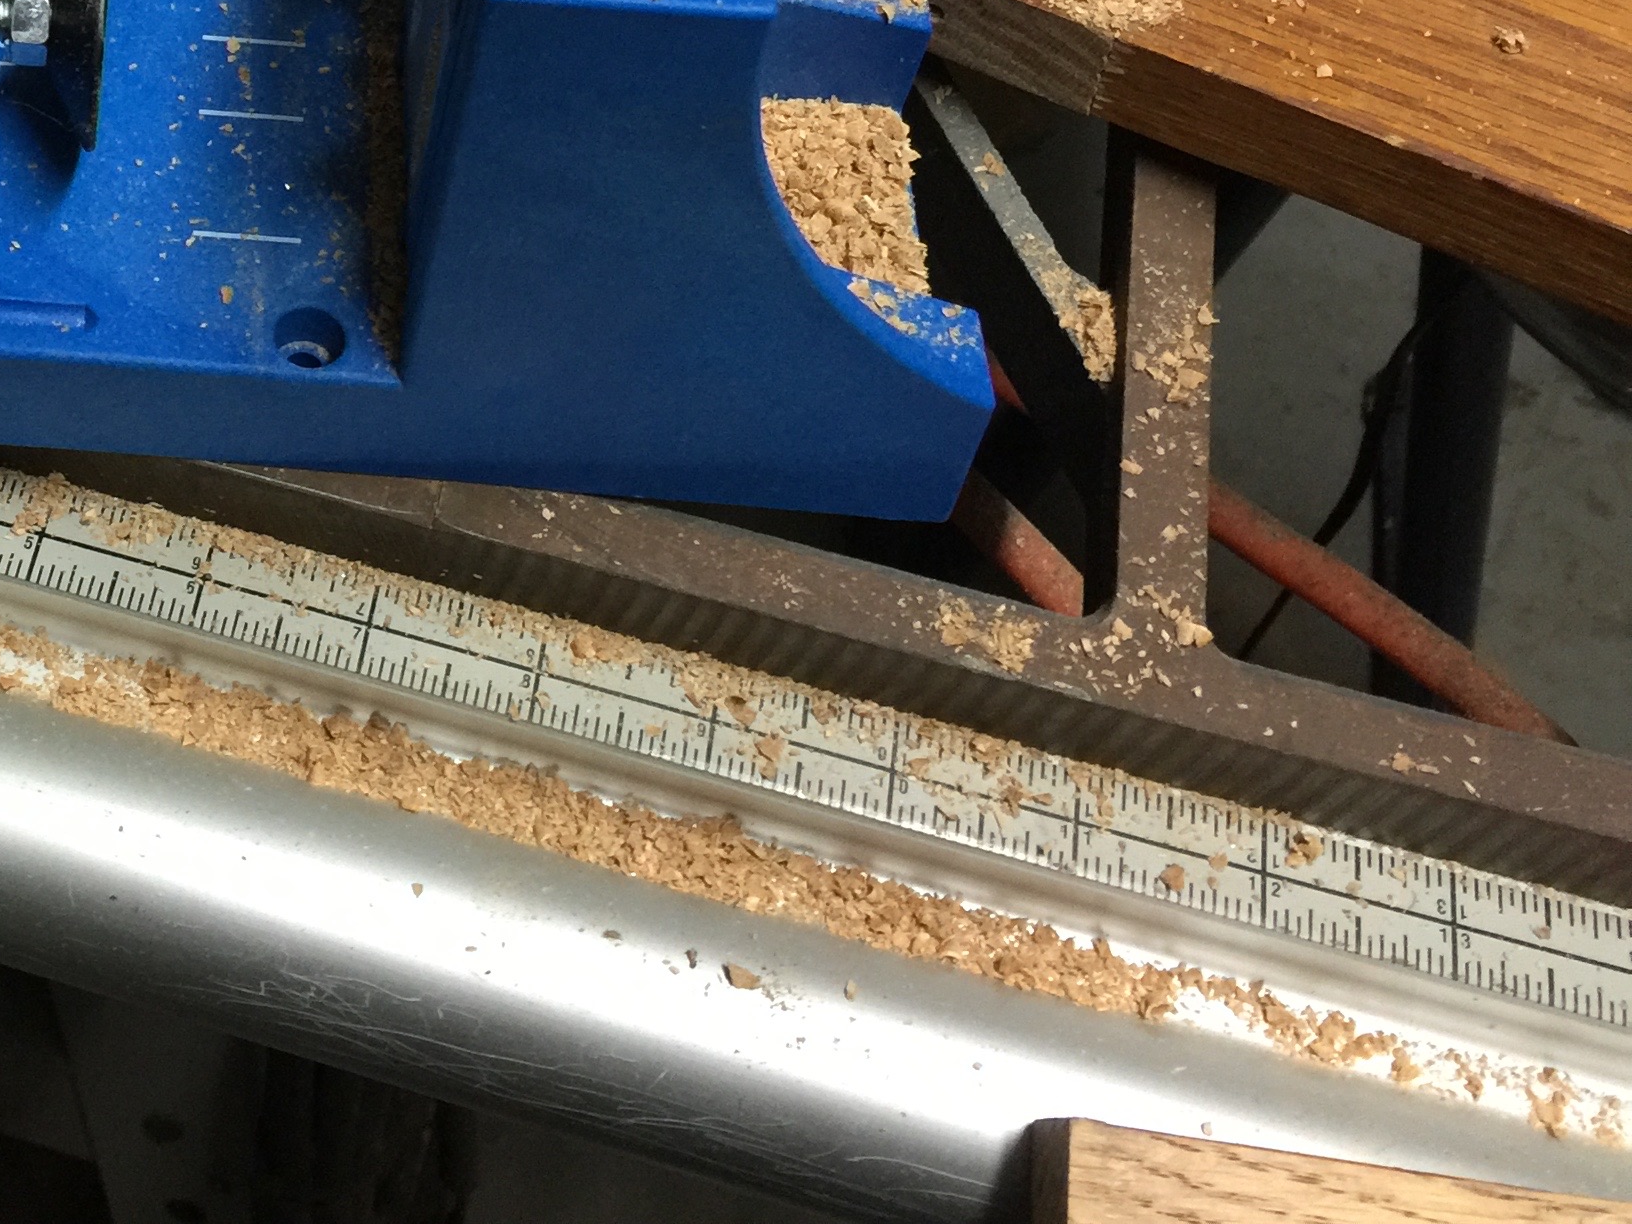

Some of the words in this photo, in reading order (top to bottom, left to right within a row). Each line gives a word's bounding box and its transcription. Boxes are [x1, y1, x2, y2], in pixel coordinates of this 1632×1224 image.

[23, 535, 35, 550] 5
[353, 626, 363, 640] 7
[519, 673, 532, 689] 8
[696, 722, 707, 737] 9
[1249, 875, 1282, 898] 12
[1439, 928, 1471, 949] 13
